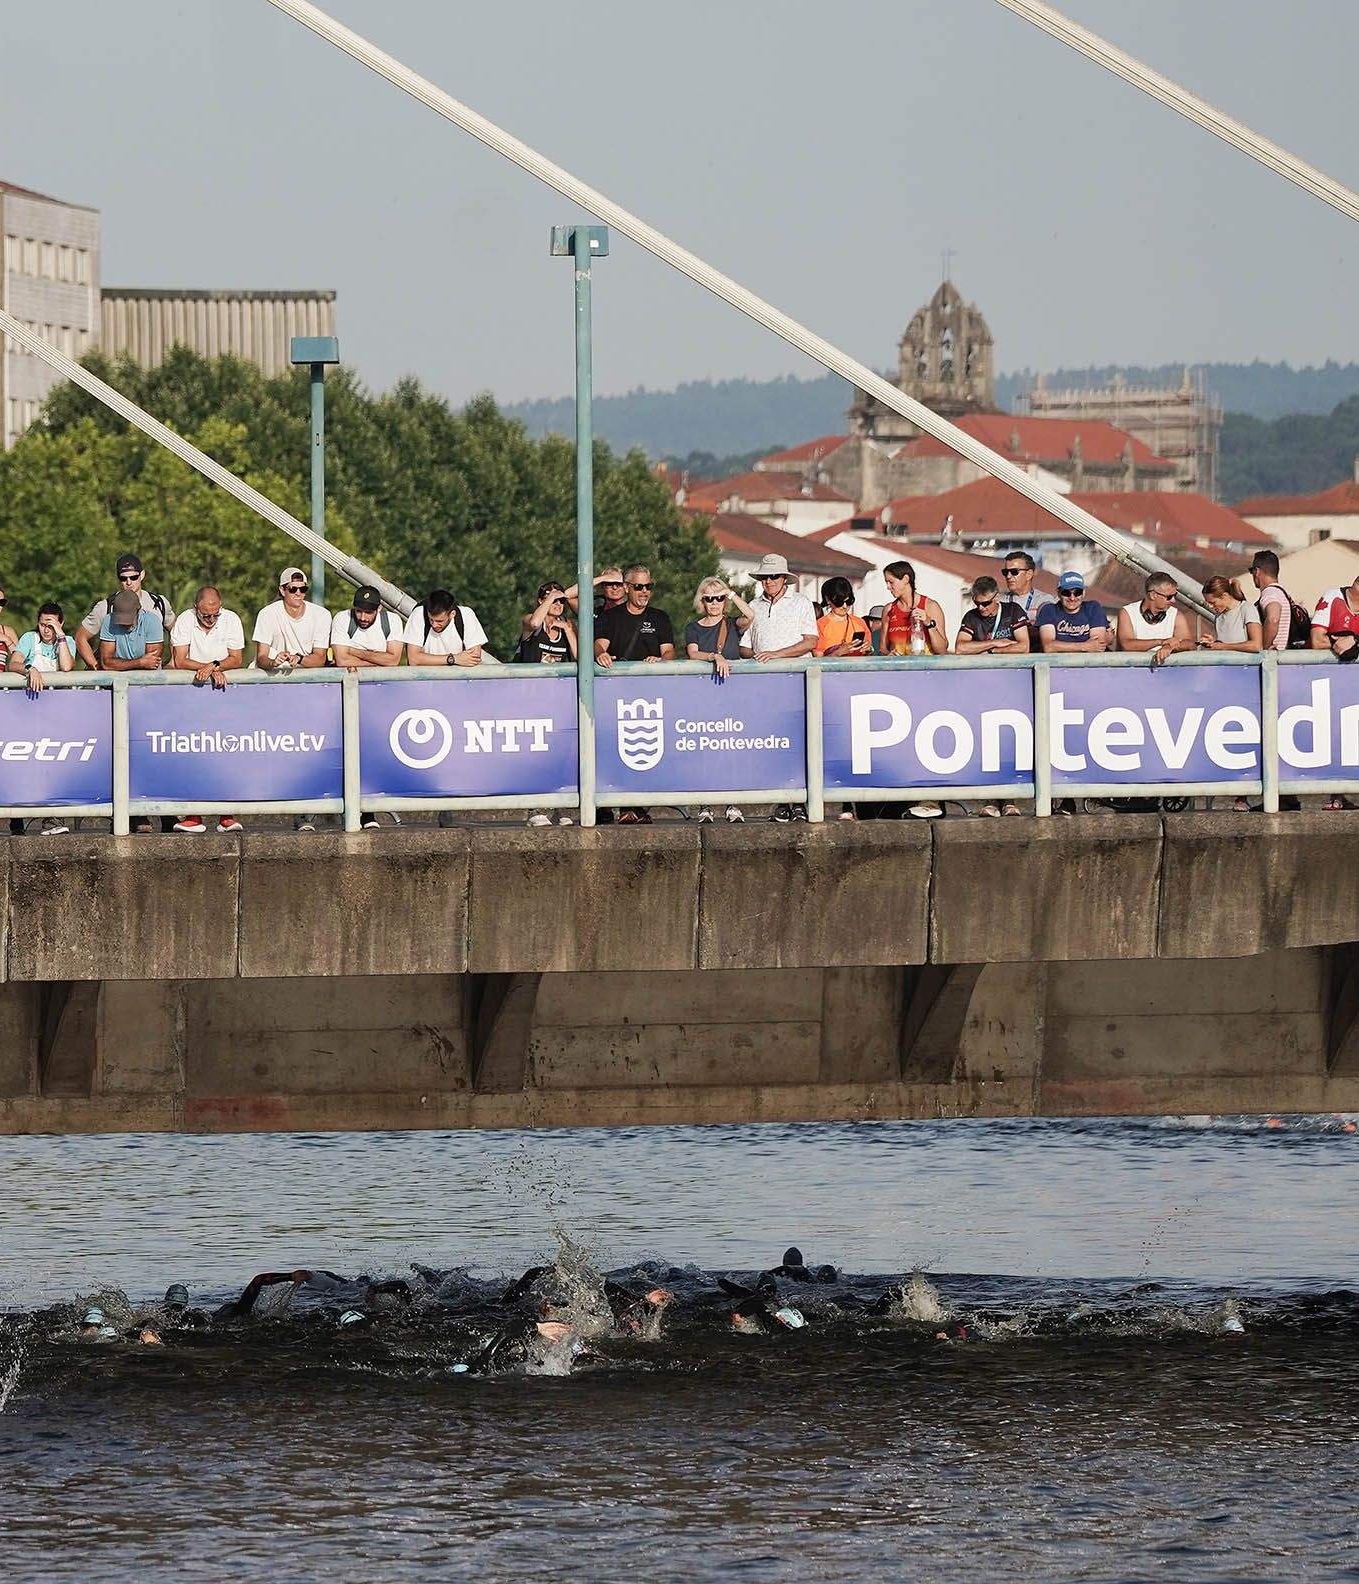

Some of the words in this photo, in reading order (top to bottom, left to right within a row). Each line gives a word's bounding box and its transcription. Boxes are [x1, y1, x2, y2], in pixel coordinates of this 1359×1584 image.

[1057, 620, 1090, 635] Chicago
[674, 717, 744, 734] Concello
[146, 730, 326, 753] Triathlonlive.tv
[463, 718, 554, 753] NTT
[675, 736, 697, 751] de
[699, 734, 790, 751] Pontevedra
